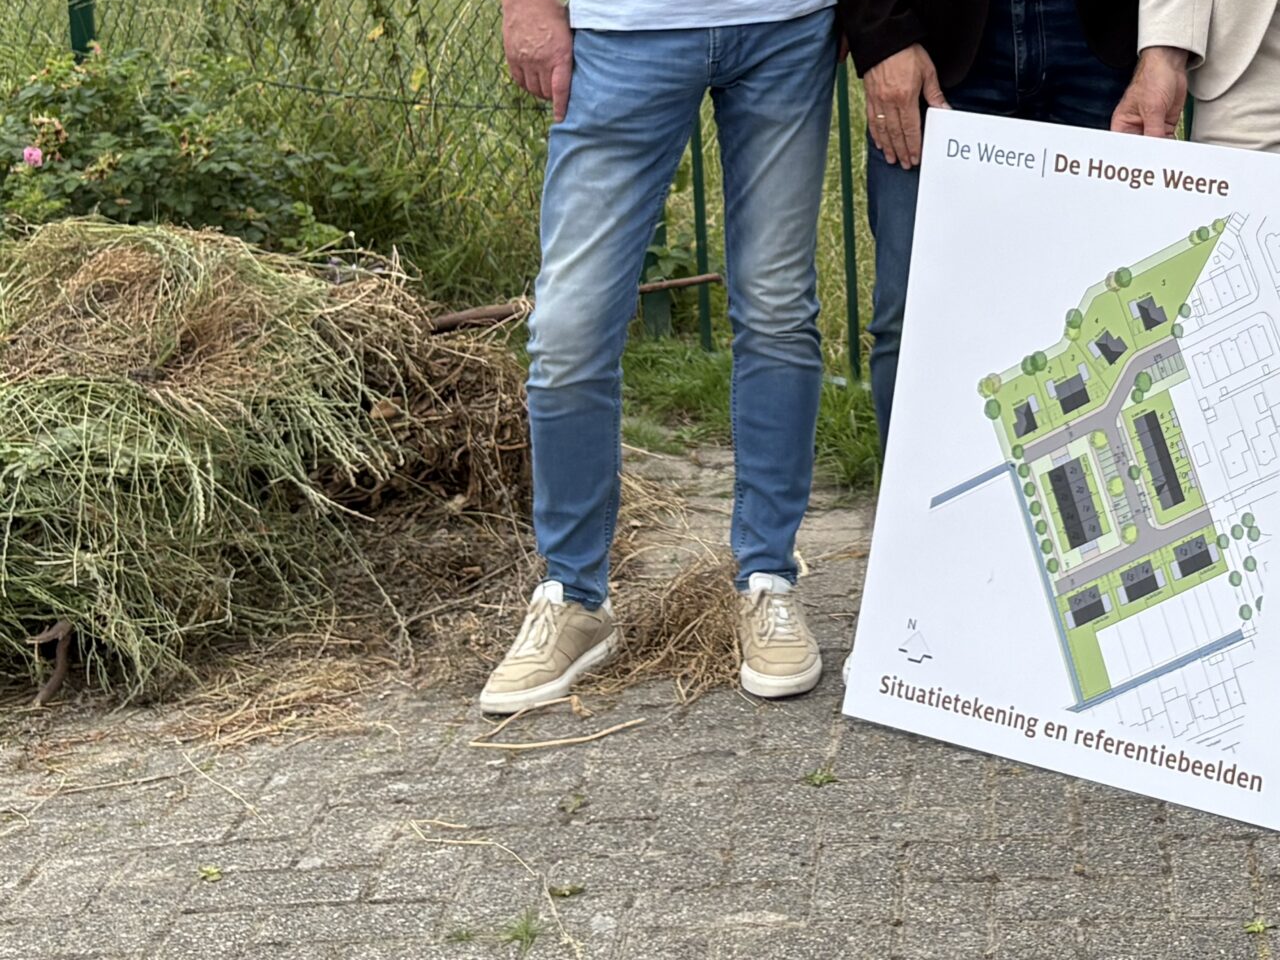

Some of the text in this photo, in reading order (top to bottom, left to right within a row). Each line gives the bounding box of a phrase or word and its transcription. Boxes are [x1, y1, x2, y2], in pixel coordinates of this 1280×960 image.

[946, 138, 1230, 197] De Weere De Hooge Weere
[907, 618, 917, 631] N
[878, 675, 1263, 793] Situatietekening en referentiebeelden
